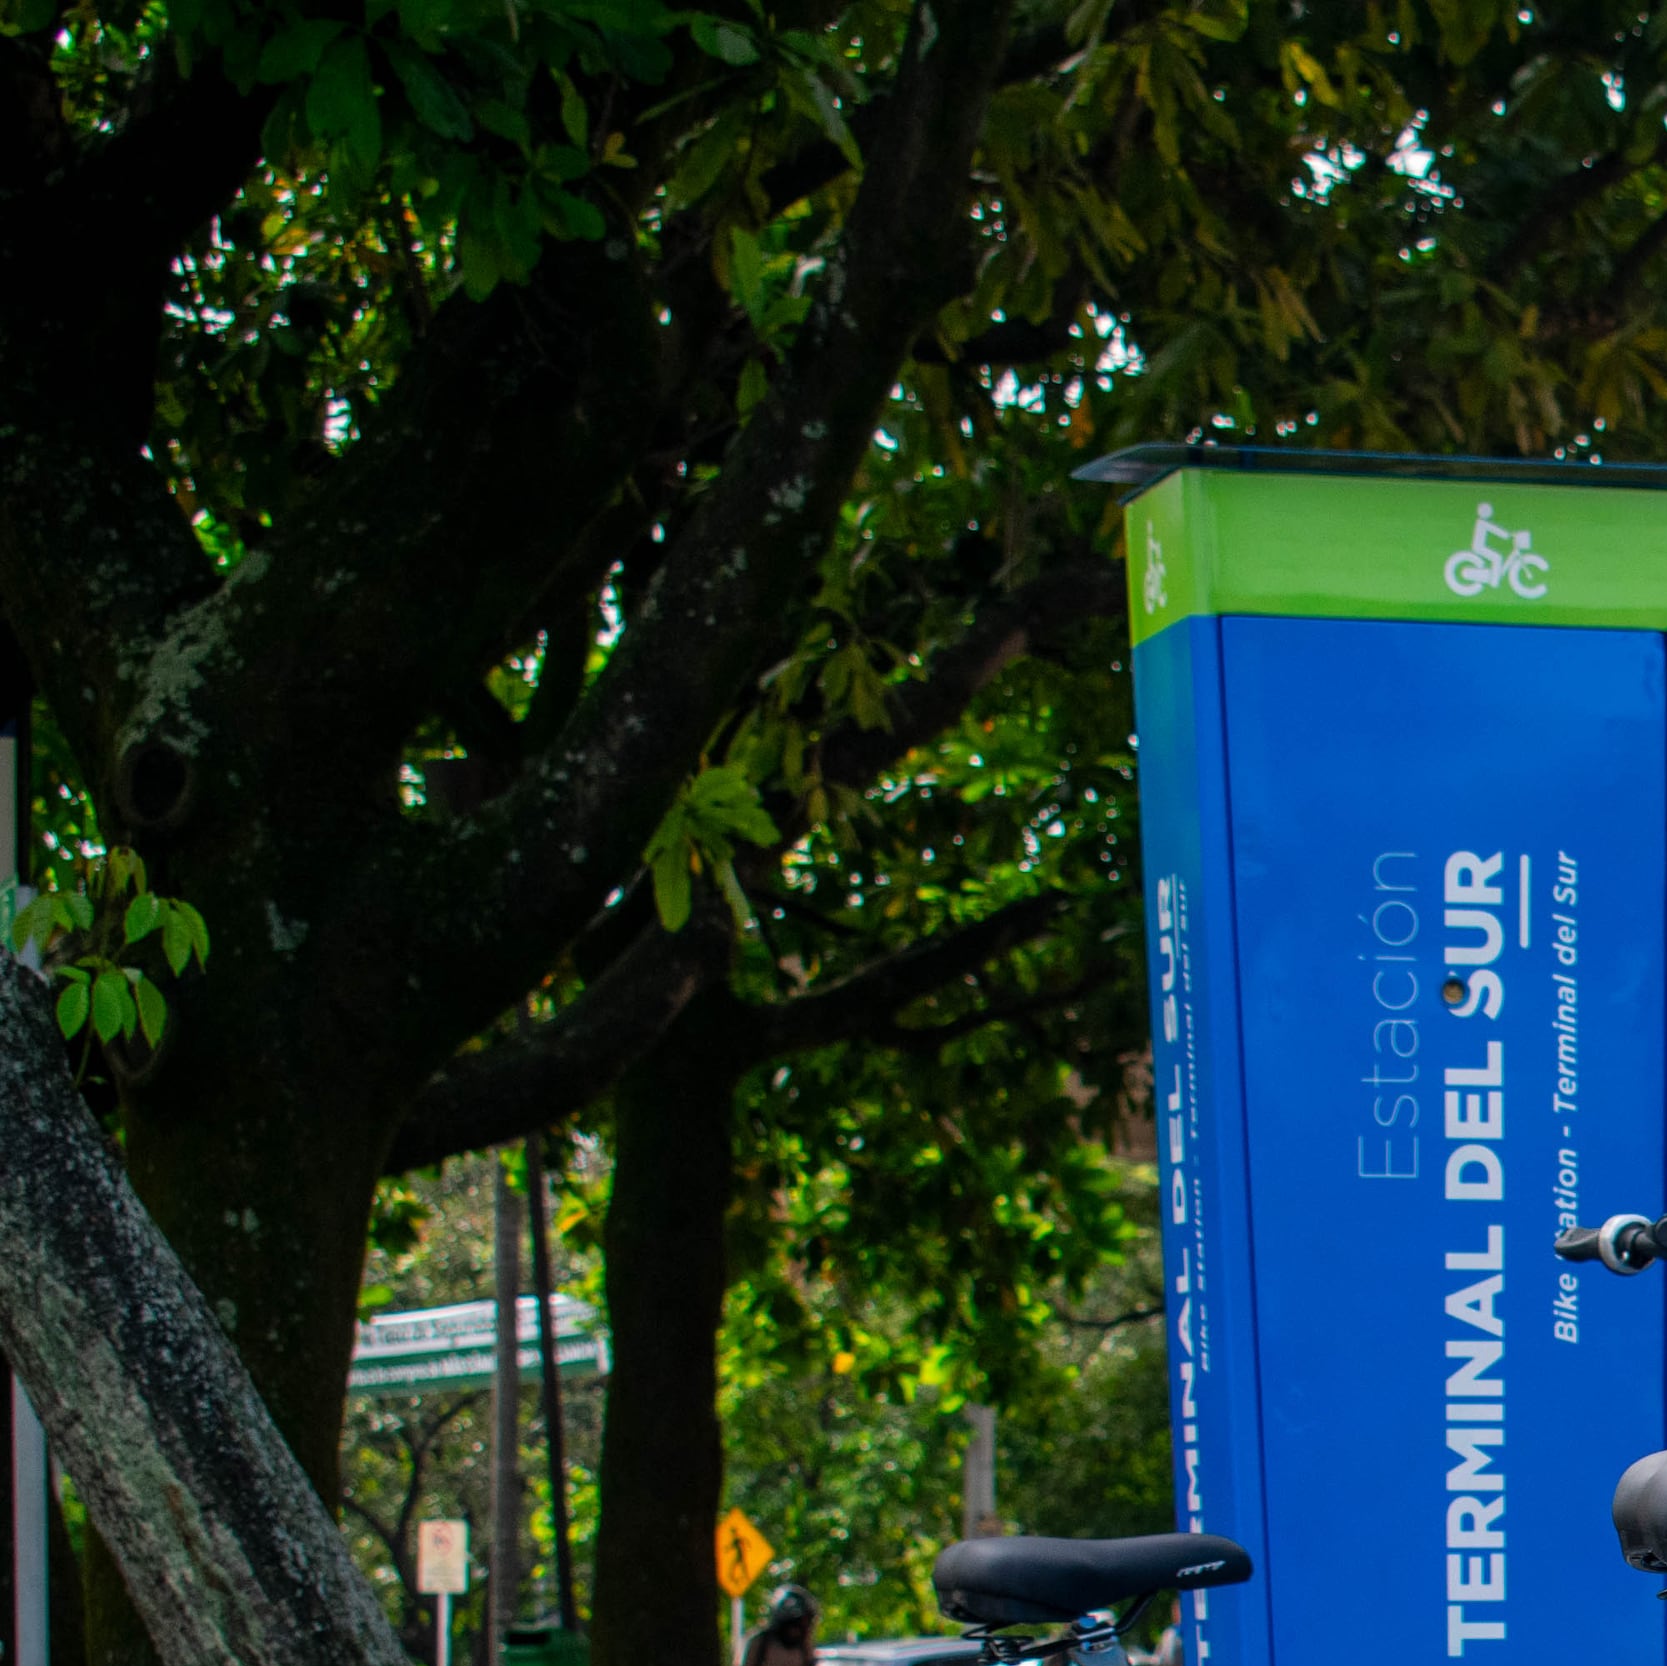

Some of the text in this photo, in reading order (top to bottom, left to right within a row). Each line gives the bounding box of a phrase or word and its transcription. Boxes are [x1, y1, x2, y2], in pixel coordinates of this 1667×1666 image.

[1553, 850, 1579, 905] Sur
[1553, 912, 1578, 966] del
[1157, 878, 1179, 1042] SUR
[1358, 851, 1418, 1178] Estación
[1553, 974, 1578, 1114] Terminal
[1168, 1063, 1188, 1224] DEL
[1553, 1150, 1579, 1260] ation
[1445, 850, 1506, 1656] TERMINAL DEL SUR
[1554, 1273, 1579, 1343] Bike
